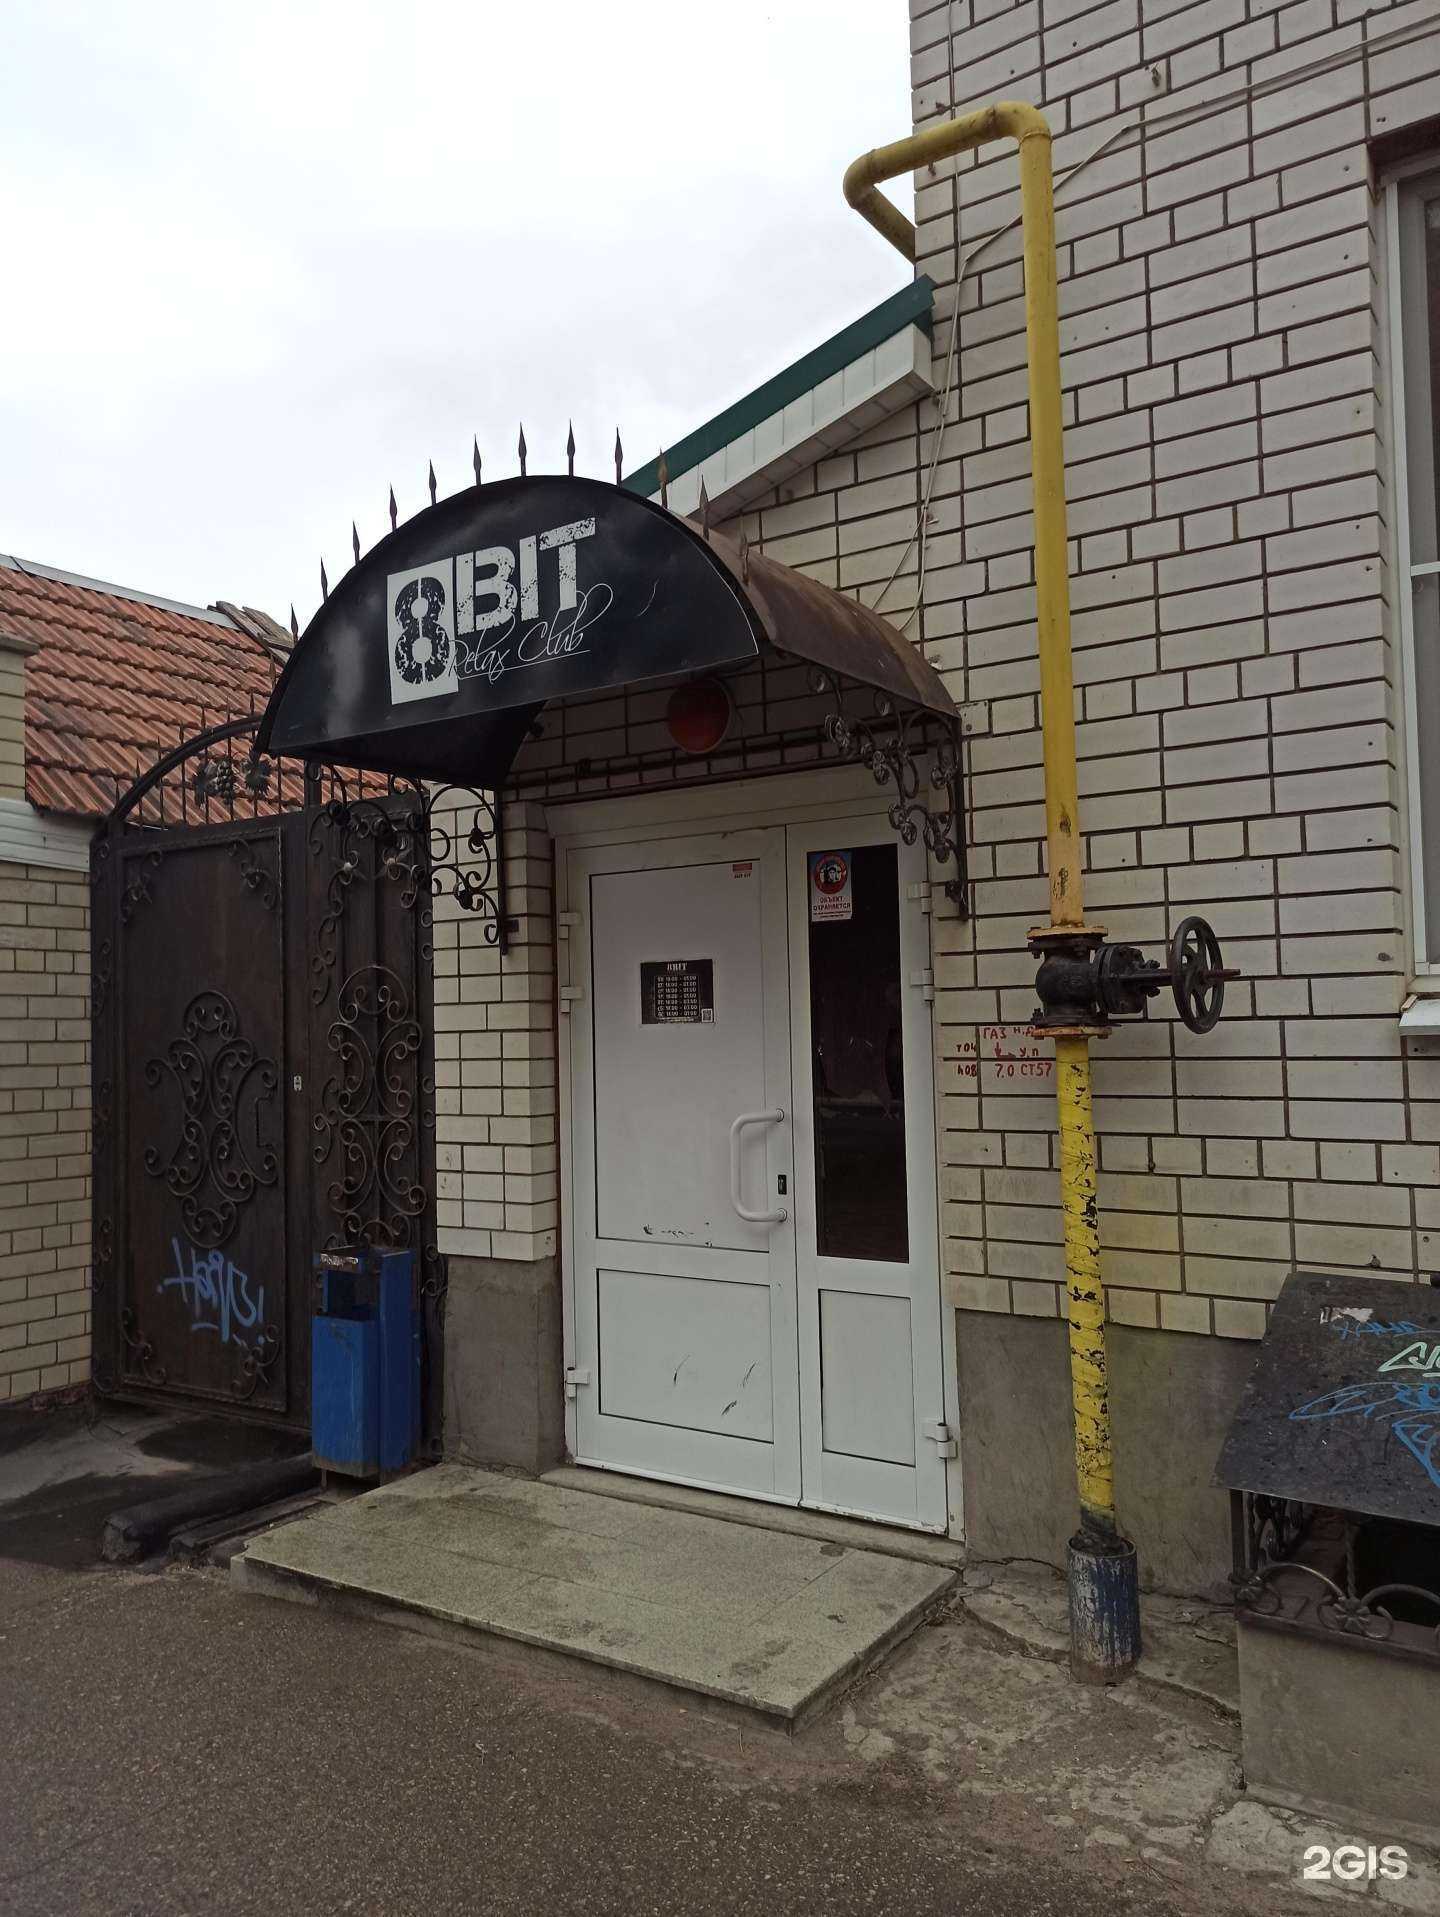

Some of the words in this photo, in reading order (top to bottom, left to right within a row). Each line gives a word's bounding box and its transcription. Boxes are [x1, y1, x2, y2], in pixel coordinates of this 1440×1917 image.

[393, 517, 597, 685] 8BIT
[448, 613, 517, 685] Relax
[518, 582, 614, 661] Club
[982, 1026, 1007, 1040] ГАЗ
